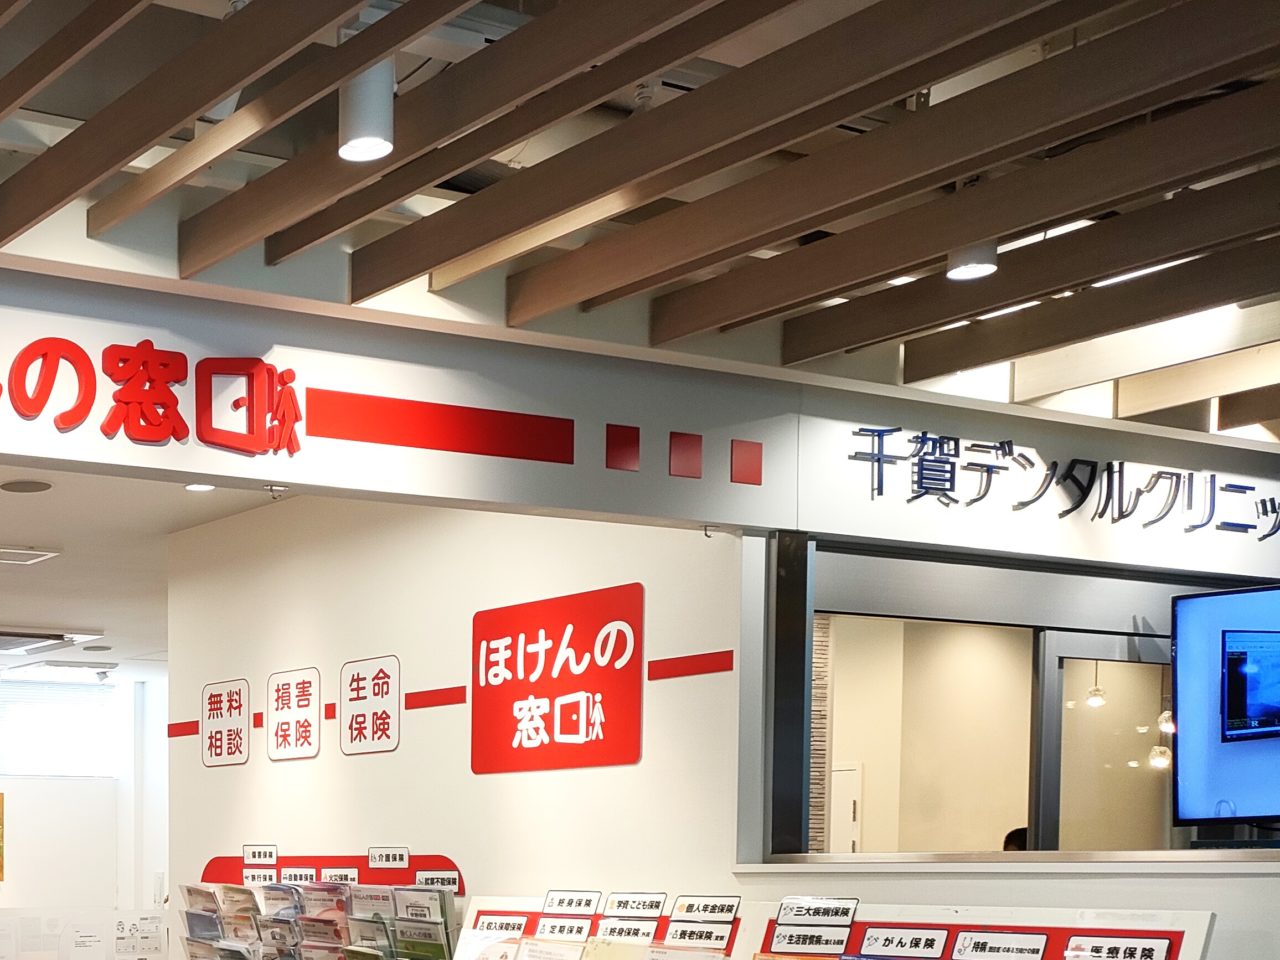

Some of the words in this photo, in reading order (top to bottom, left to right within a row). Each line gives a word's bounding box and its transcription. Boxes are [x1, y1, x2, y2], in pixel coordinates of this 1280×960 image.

[478, 620, 635, 687] ほけんの
[274, 679, 313, 712] 損害
[348, 668, 392, 702] 生命
[207, 688, 243, 720] 無料
[274, 720, 313, 749] 保険
[348, 709, 392, 744] 保険
[511, 690, 592, 749] 窓口
[207, 729, 243, 758] 相談
[686, 904, 735, 913] 個人年金保険
[794, 907, 851, 917] 三大疾病保険
[679, 930, 714, 940] 養老保険
[882, 937, 936, 949] がん保険
